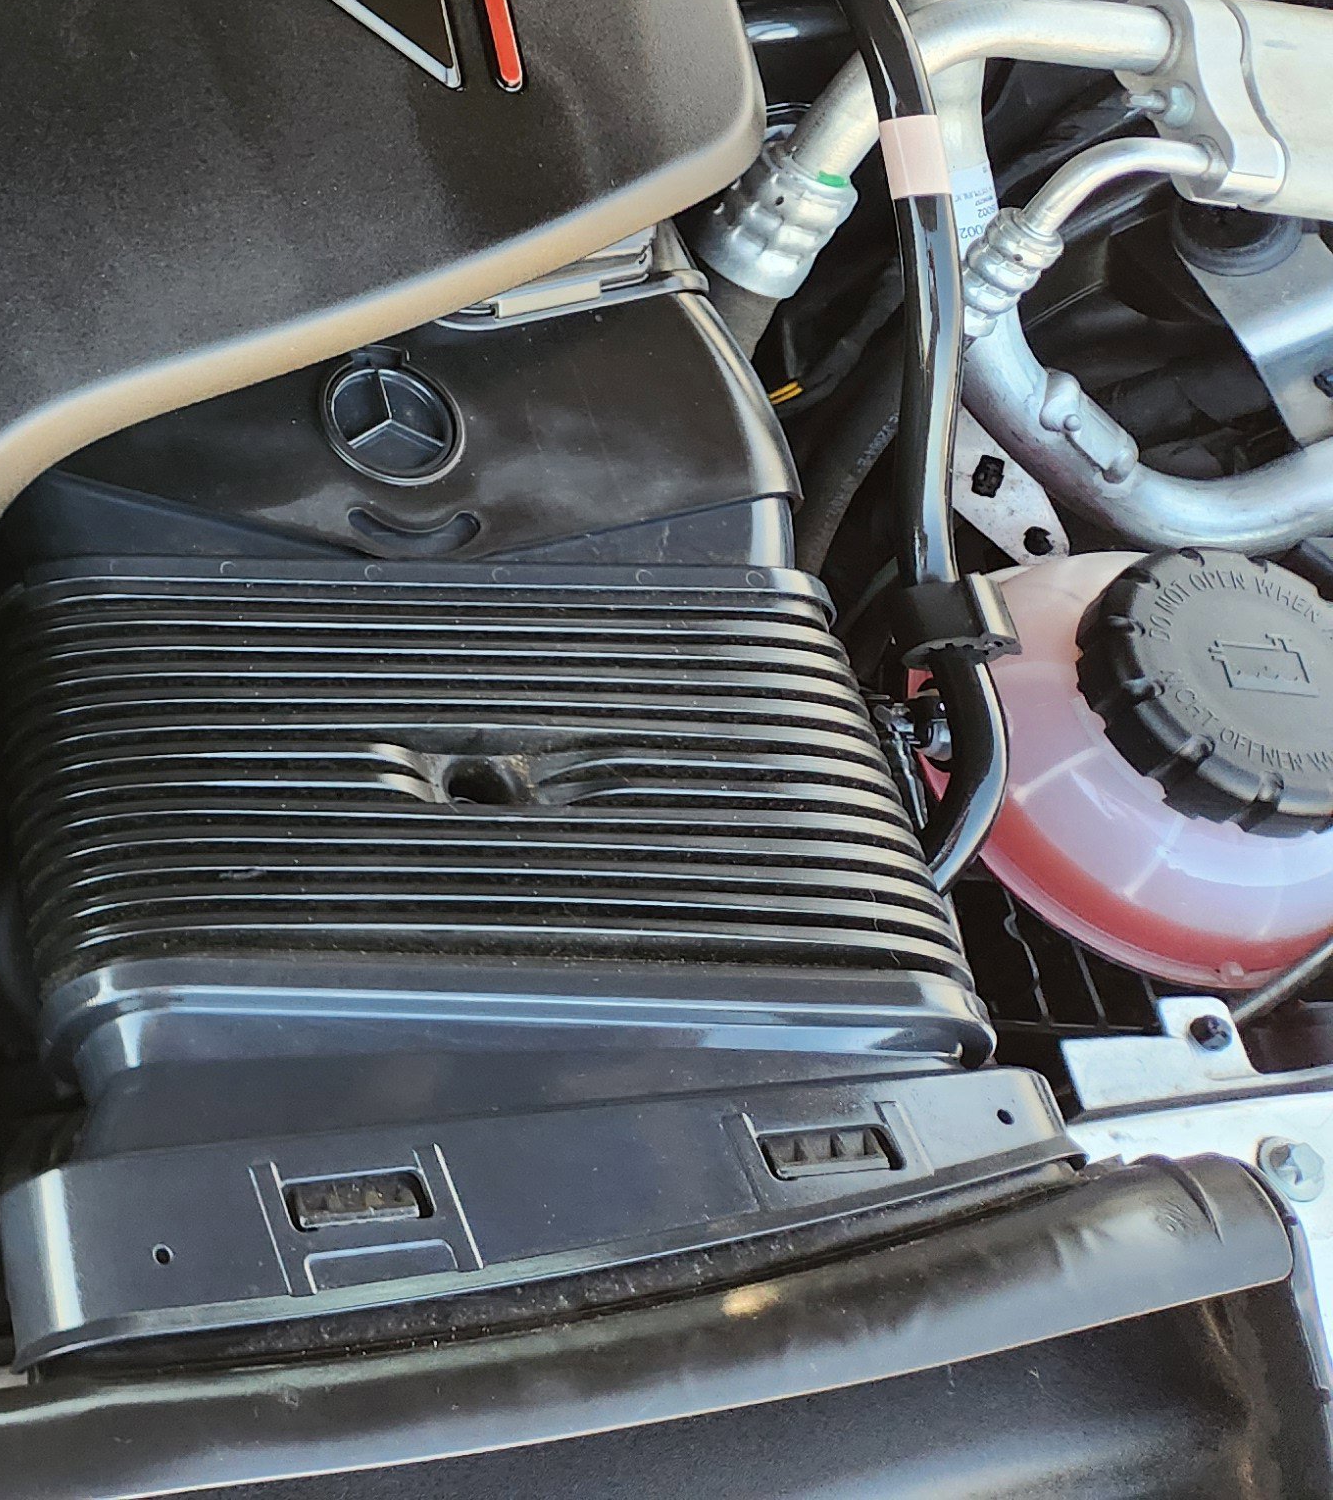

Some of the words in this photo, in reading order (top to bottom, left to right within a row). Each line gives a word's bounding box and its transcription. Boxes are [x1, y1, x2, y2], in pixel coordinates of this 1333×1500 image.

[1154, 579, 1190, 616] NOT
[1189, 569, 1246, 591] OPEN
[1254, 576, 1321, 624] WHEN
